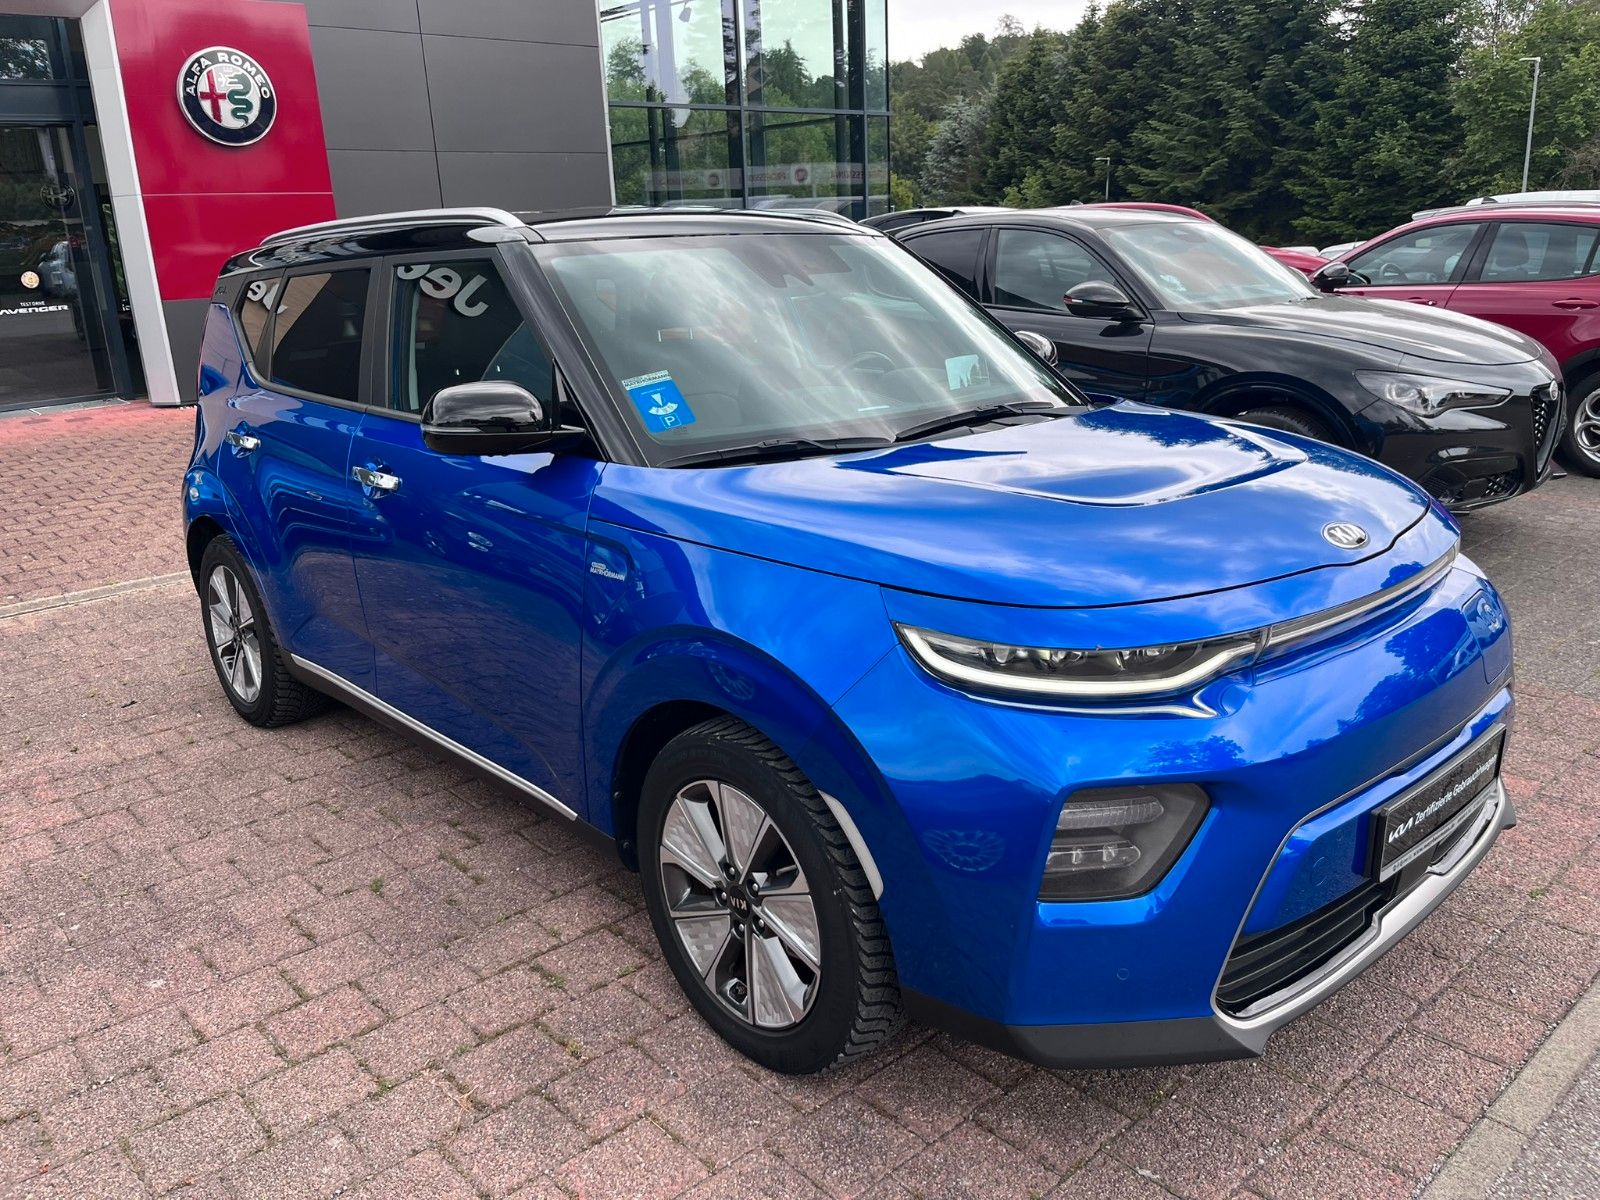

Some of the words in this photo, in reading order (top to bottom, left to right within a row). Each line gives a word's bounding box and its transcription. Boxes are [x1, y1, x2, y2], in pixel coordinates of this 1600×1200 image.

[186, 57, 212, 96] ALFA
[216, 52, 270, 99] ROMEO
[0, 304, 69, 316] AVENGER
[664, 415, 675, 427] P
[1414, 790, 1453, 825] Zertifizierte
[1453, 754, 1498, 797] Gebrauchtwagen
[730, 895, 748, 910] KIA
